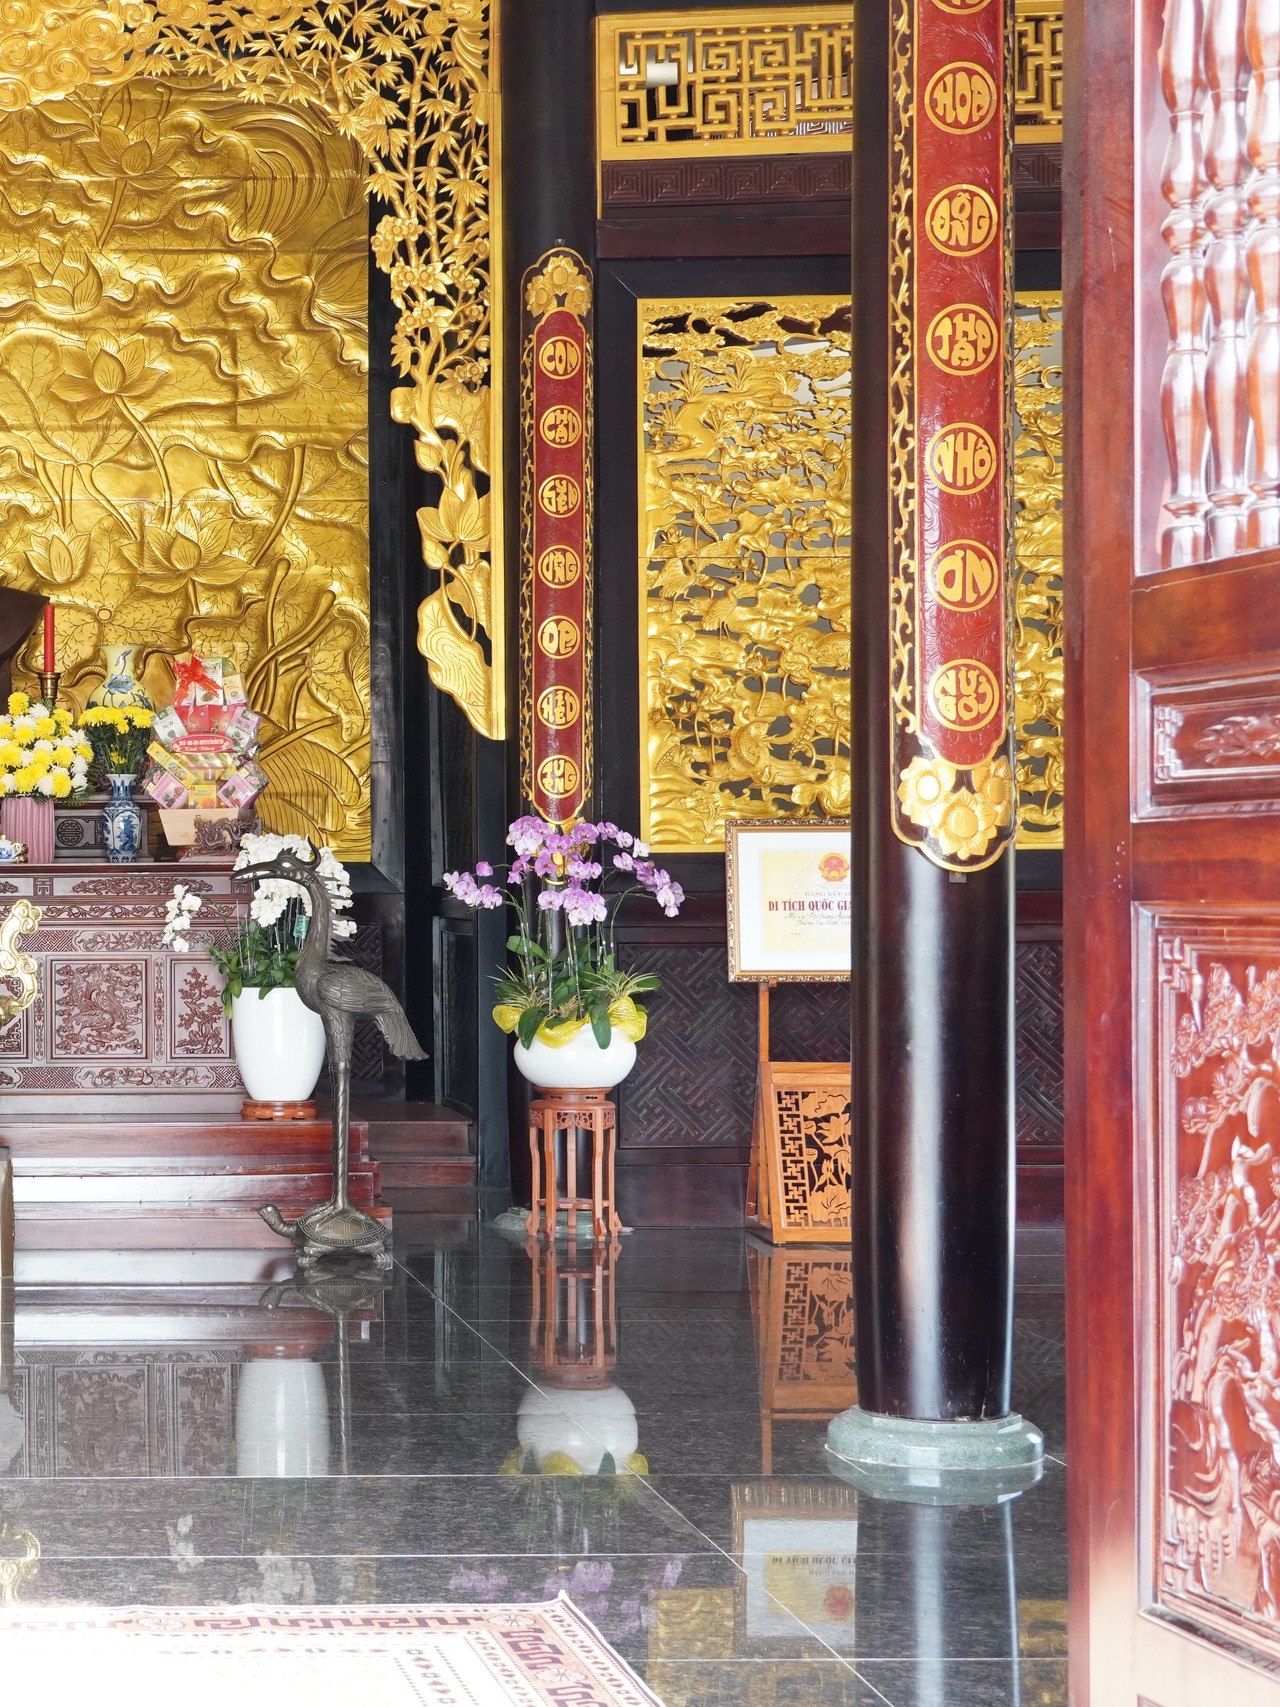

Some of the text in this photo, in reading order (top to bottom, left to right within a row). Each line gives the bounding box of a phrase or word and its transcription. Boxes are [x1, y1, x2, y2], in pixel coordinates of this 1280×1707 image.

[934, 72, 990, 124] HOA
[543, 342, 577, 374] CON
[768, 900, 779, 911] DI
[782, 898, 805, 911] TÍCH
[808, 898, 834, 911] QUỐC
